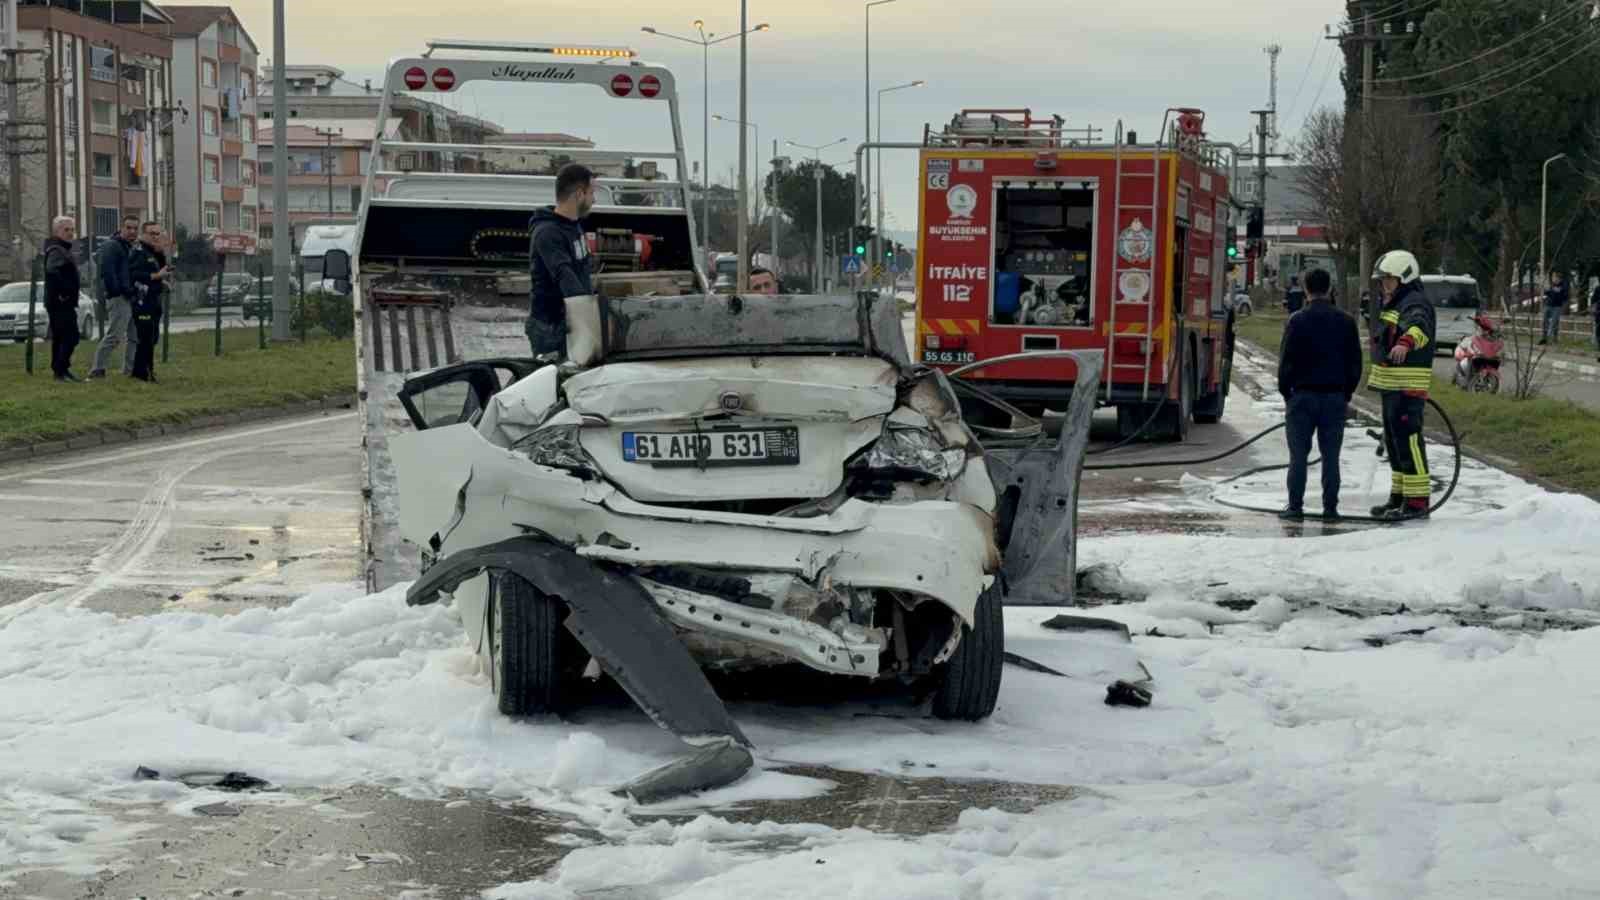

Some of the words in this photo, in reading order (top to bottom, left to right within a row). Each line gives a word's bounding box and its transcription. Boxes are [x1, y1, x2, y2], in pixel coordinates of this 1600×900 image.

[929, 263, 987, 280] İTFAİYE
[943, 284, 970, 302] 112
[926, 352, 938, 361] 55
[635, 435, 662, 458] 61
[723, 433, 765, 458] 631
